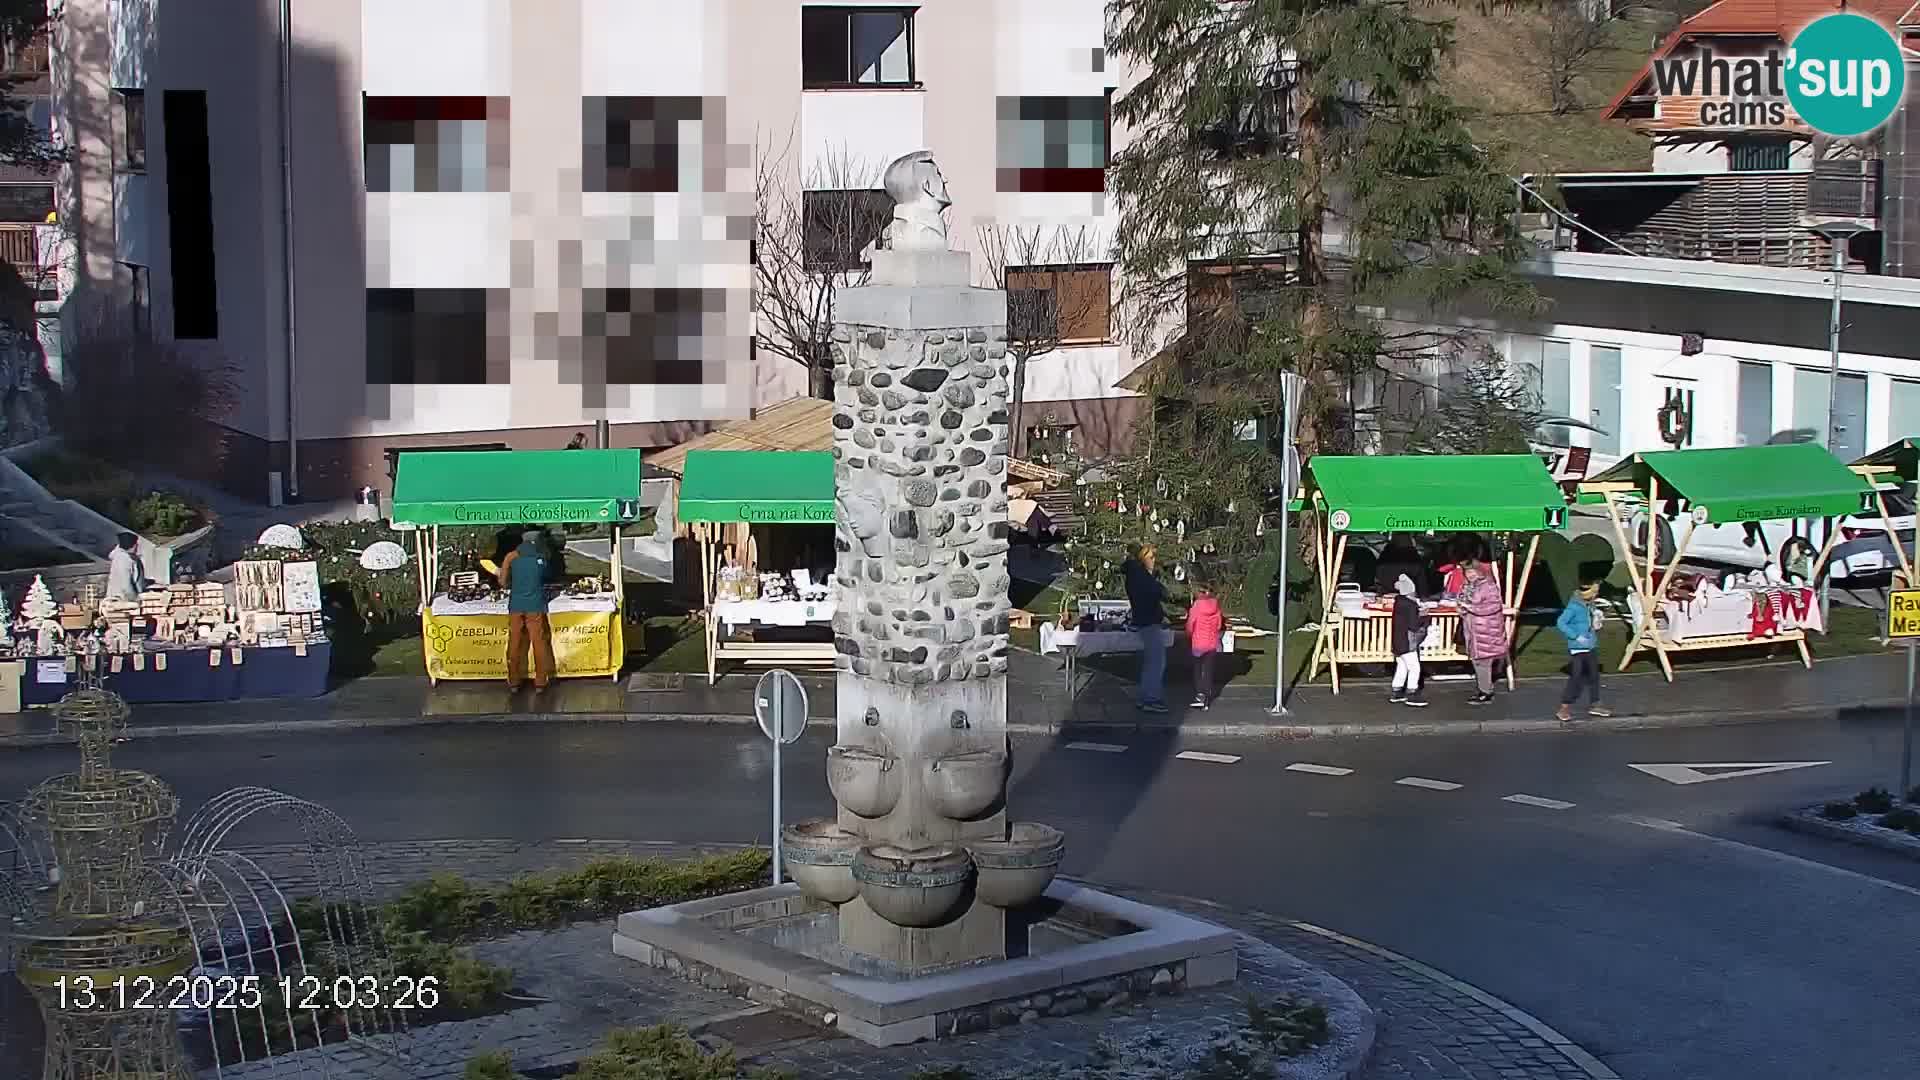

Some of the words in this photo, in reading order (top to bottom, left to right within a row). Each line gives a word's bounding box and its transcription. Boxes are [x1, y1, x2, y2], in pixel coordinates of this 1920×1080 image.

[455, 504, 491, 521] Črna
[496, 509, 513, 521] na
[781, 509, 797, 520] na
[1386, 514, 1415, 528] Črna
[1419, 518, 1433, 528] na
[1437, 516, 1494, 528] Koroškem
[455, 625, 497, 637] ČEBELJI
[1893, 616, 1920, 633] Me
